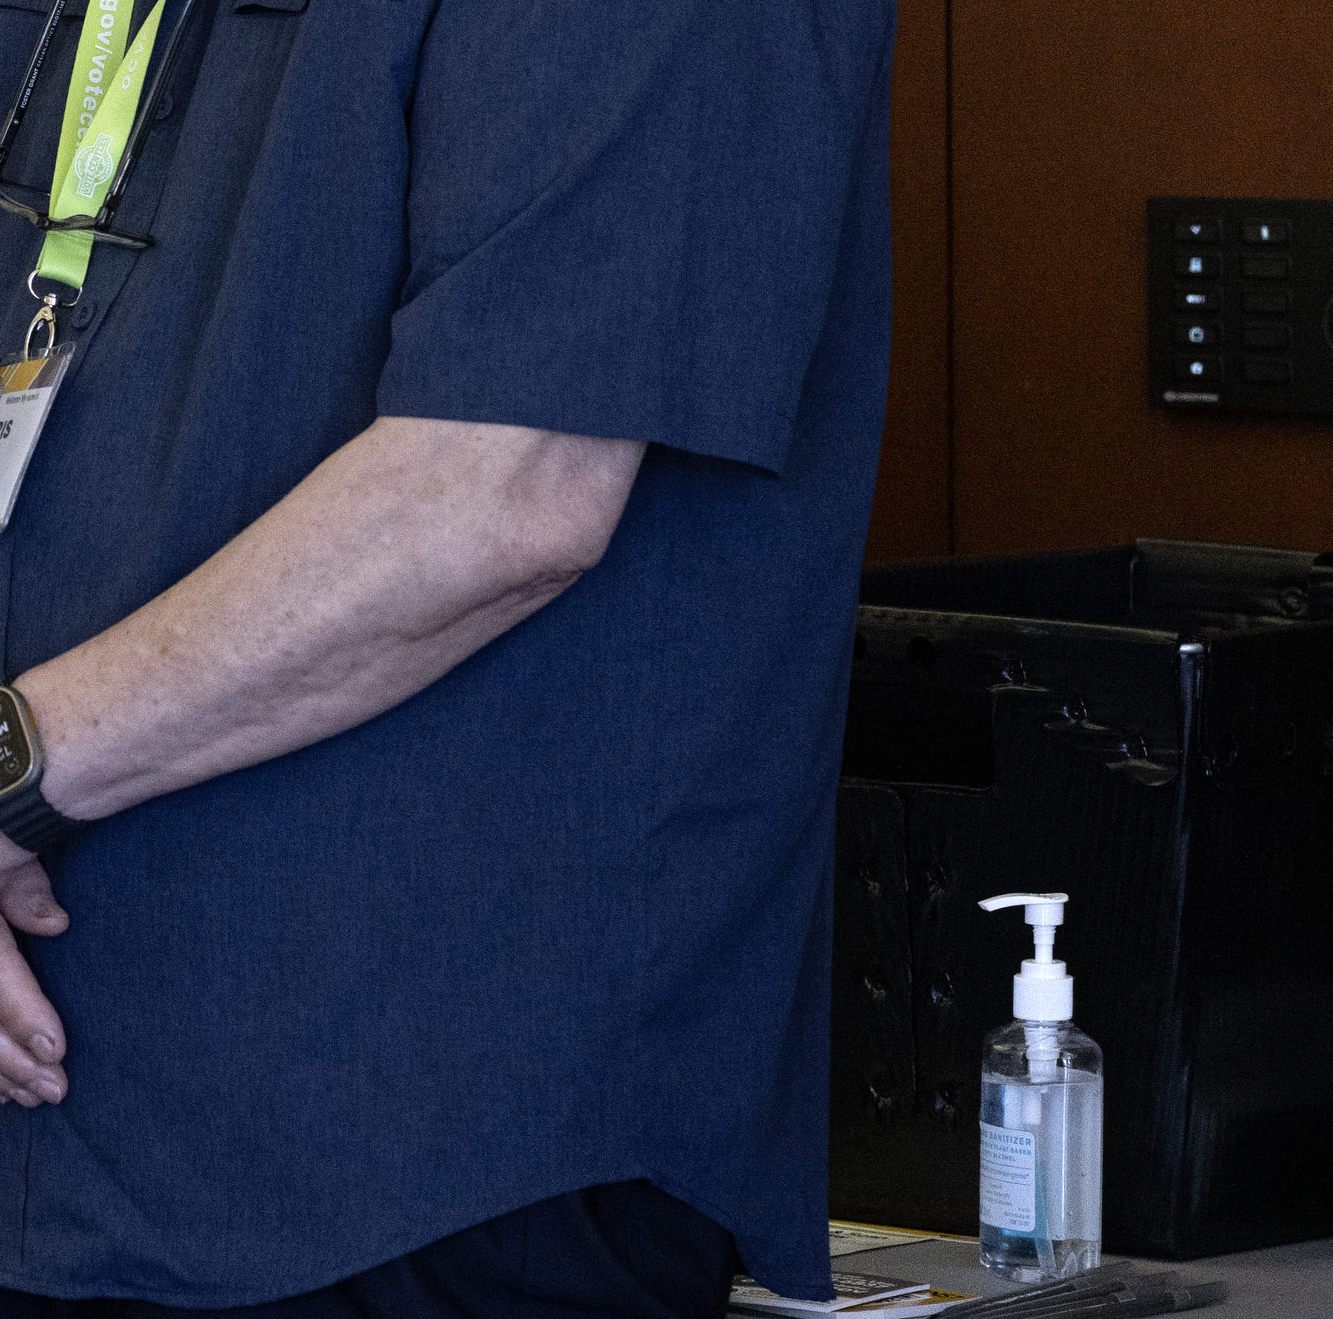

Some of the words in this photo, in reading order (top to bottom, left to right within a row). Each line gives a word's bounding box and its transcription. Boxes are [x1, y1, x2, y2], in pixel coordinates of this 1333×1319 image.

[20, 88, 32, 109] FOSTER
[28, 67, 39, 88] GRANT
[989, 1131, 1032, 1146] SANITIZER
